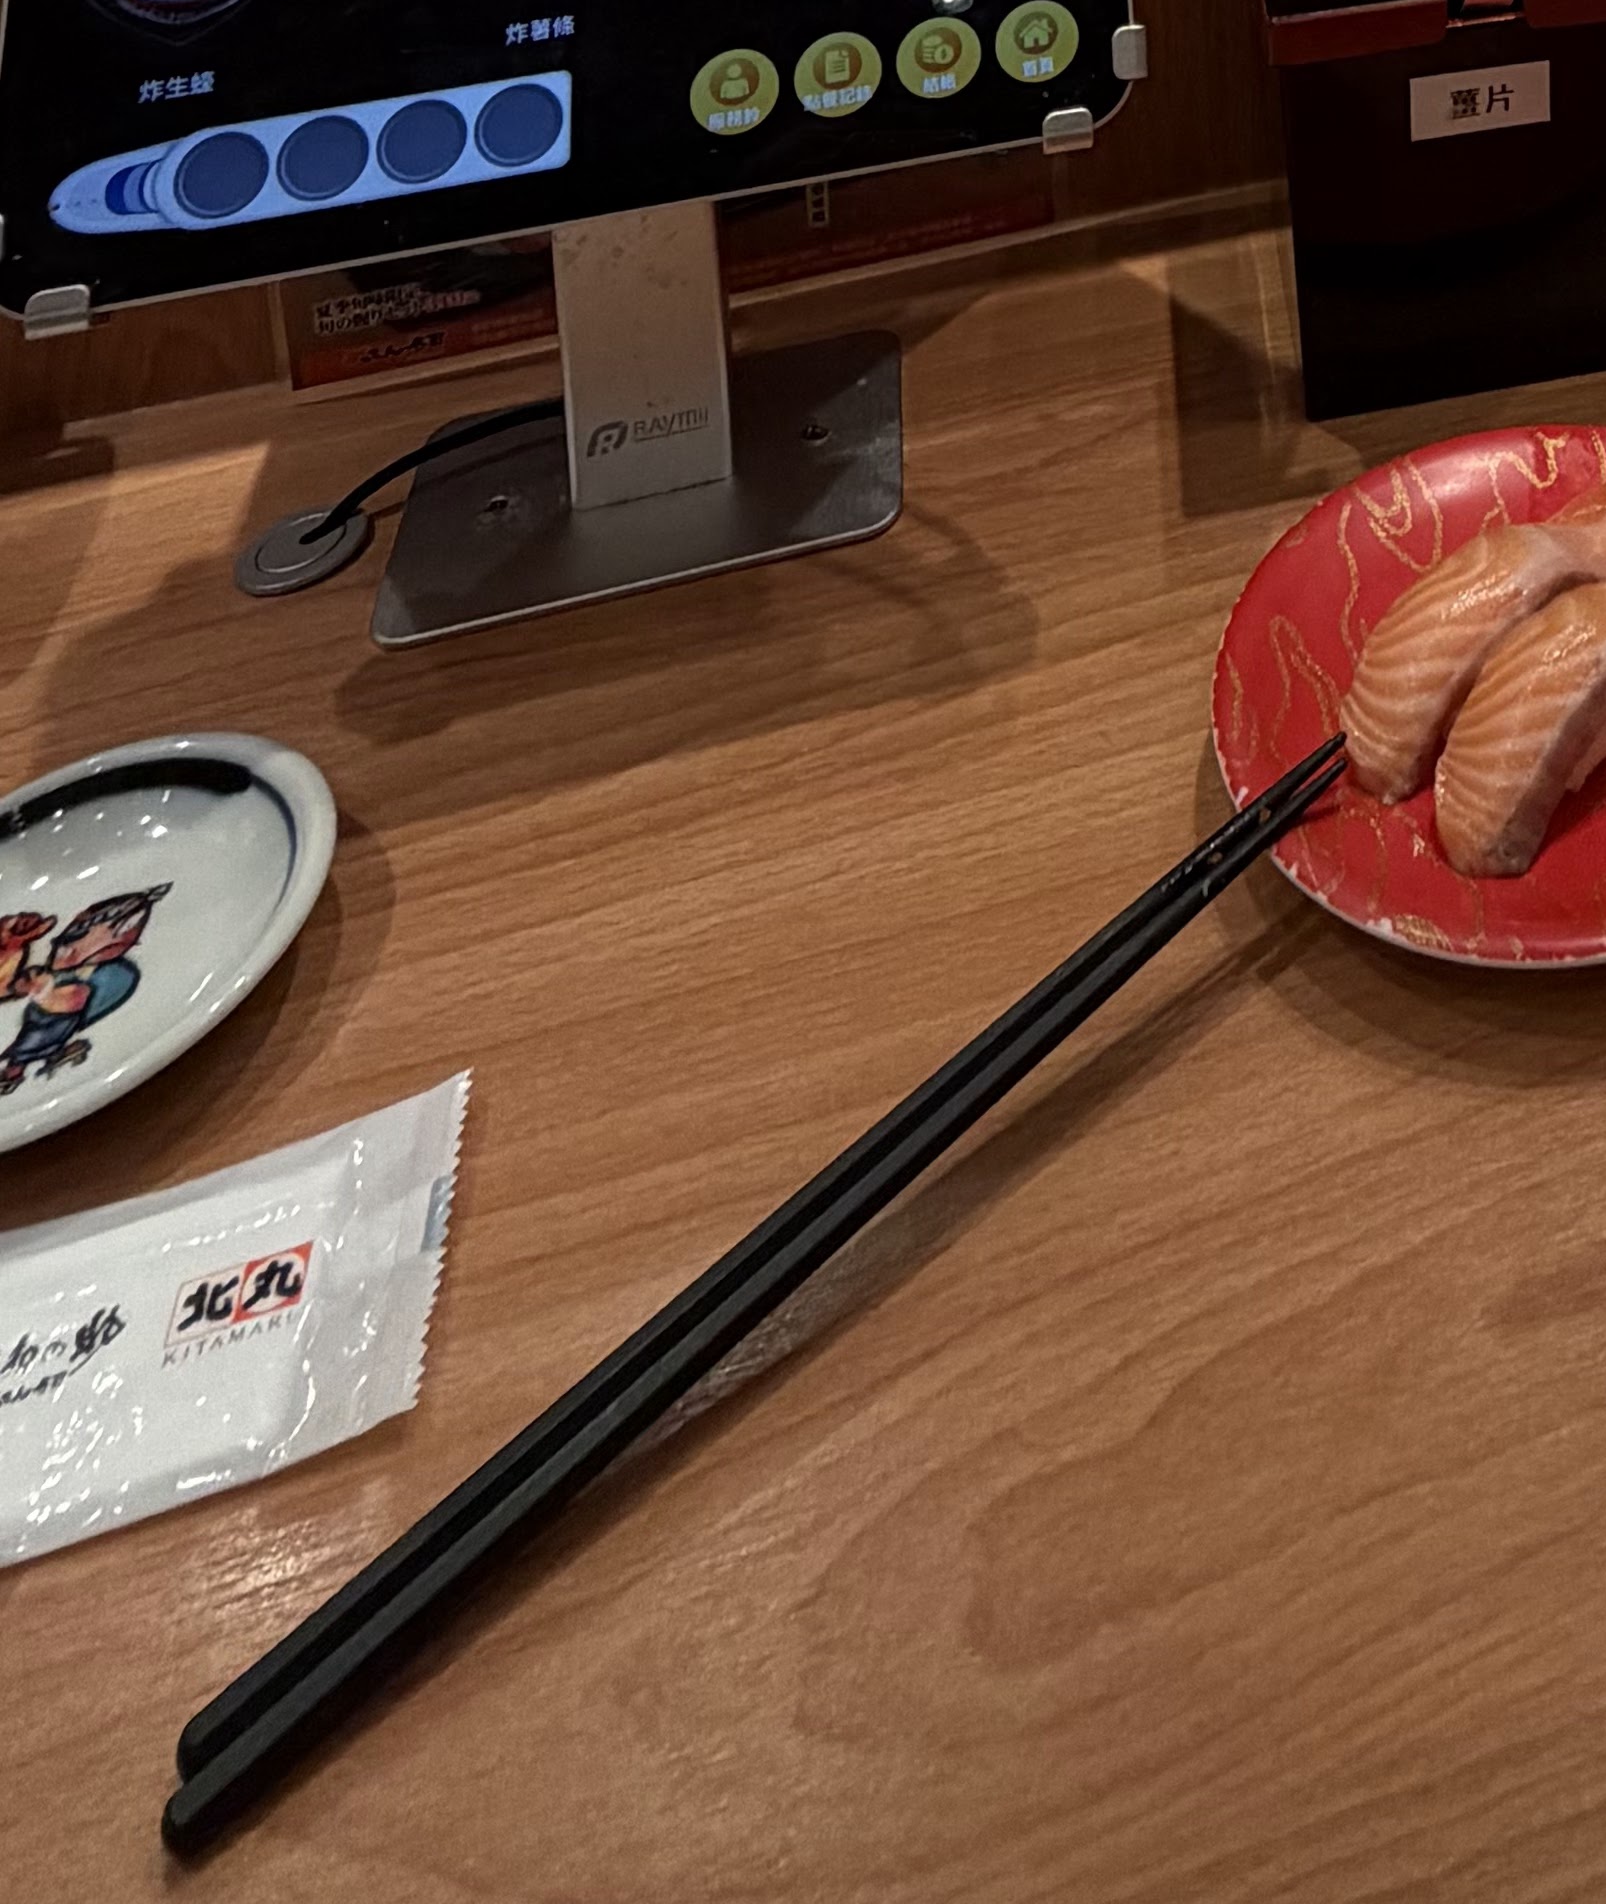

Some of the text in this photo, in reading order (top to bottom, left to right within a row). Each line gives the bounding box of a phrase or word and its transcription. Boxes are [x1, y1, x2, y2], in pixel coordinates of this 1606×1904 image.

[504, 15, 576, 46] 炸薯條
[178, 1261, 304, 1333] 北丸
